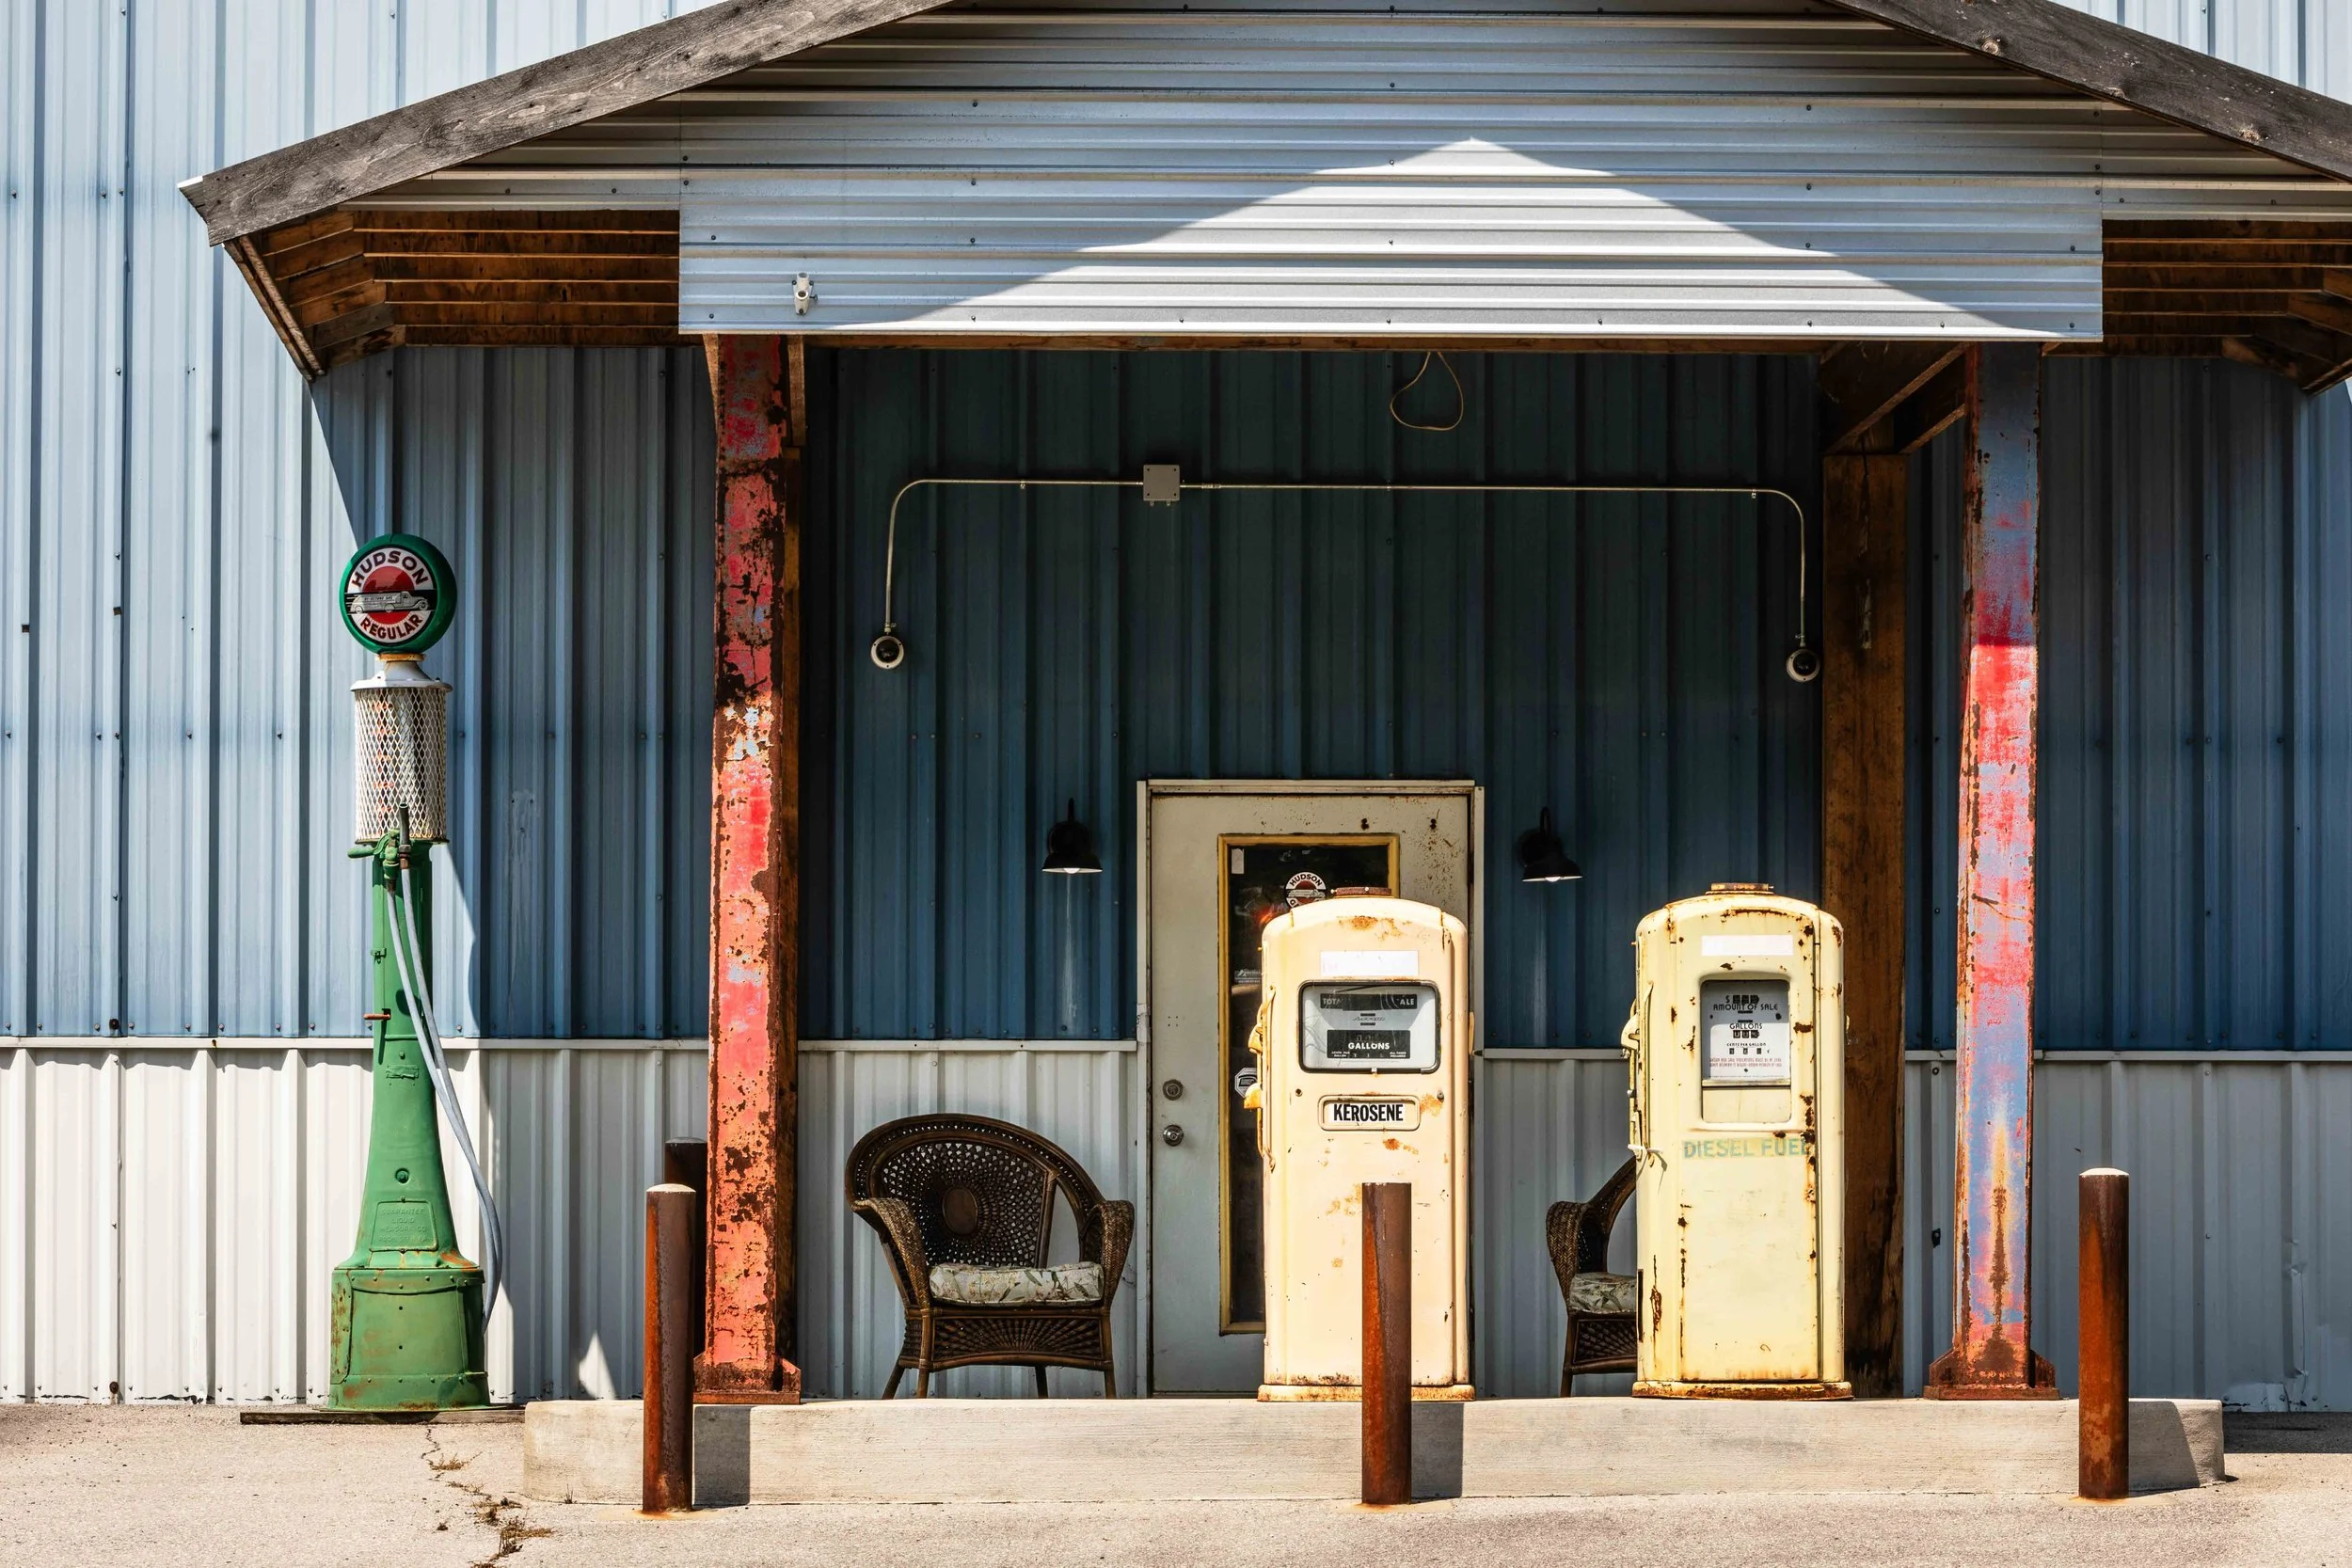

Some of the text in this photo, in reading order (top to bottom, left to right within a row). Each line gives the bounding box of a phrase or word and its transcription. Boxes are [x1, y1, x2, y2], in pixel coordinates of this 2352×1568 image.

[351, 550, 429, 588] HUDSON
[359, 614, 423, 640] REGULAR
[1289, 873, 1323, 887] HUDSON
[1333, 1103, 1404, 1121] KEROSENE
[1683, 1137, 1809, 1159] DIESEL FUEL
